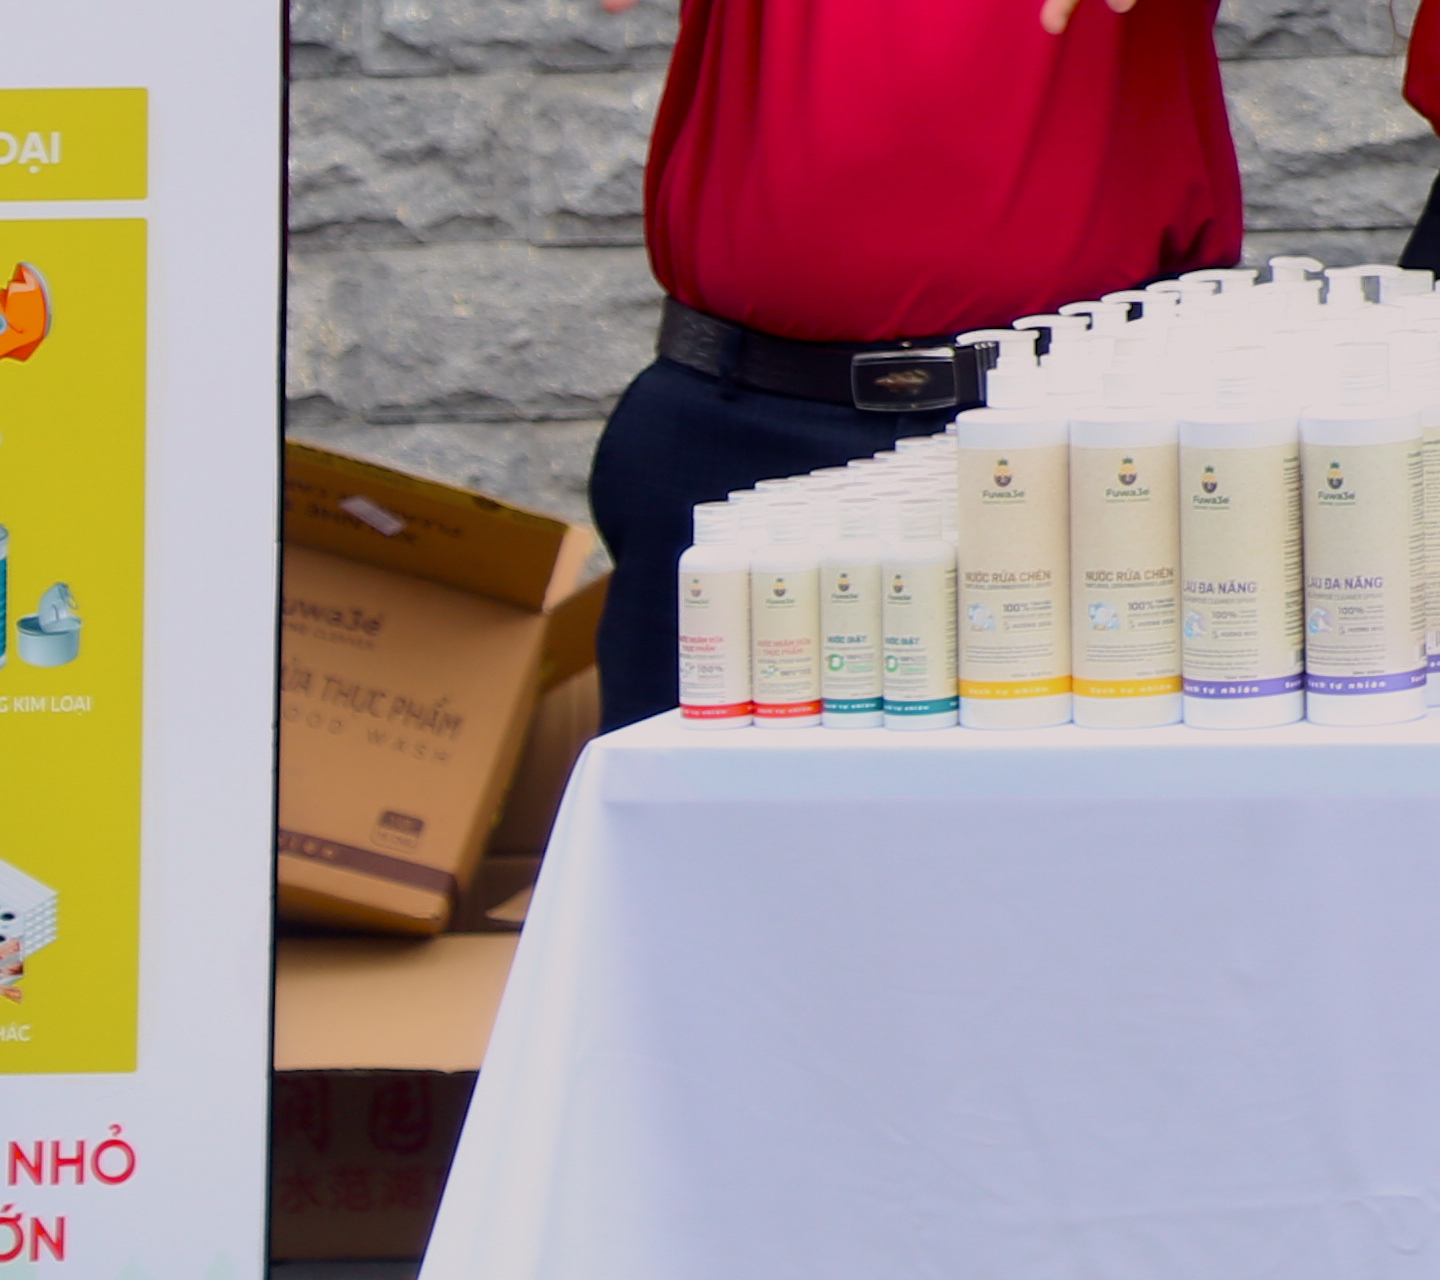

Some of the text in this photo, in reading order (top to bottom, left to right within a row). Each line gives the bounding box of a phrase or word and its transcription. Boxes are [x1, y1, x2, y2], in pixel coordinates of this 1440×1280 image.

[13, 696, 47, 713] KIM
[51, 696, 92, 716] LOẠI
[8, 1124, 136, 1186] NHỎ
